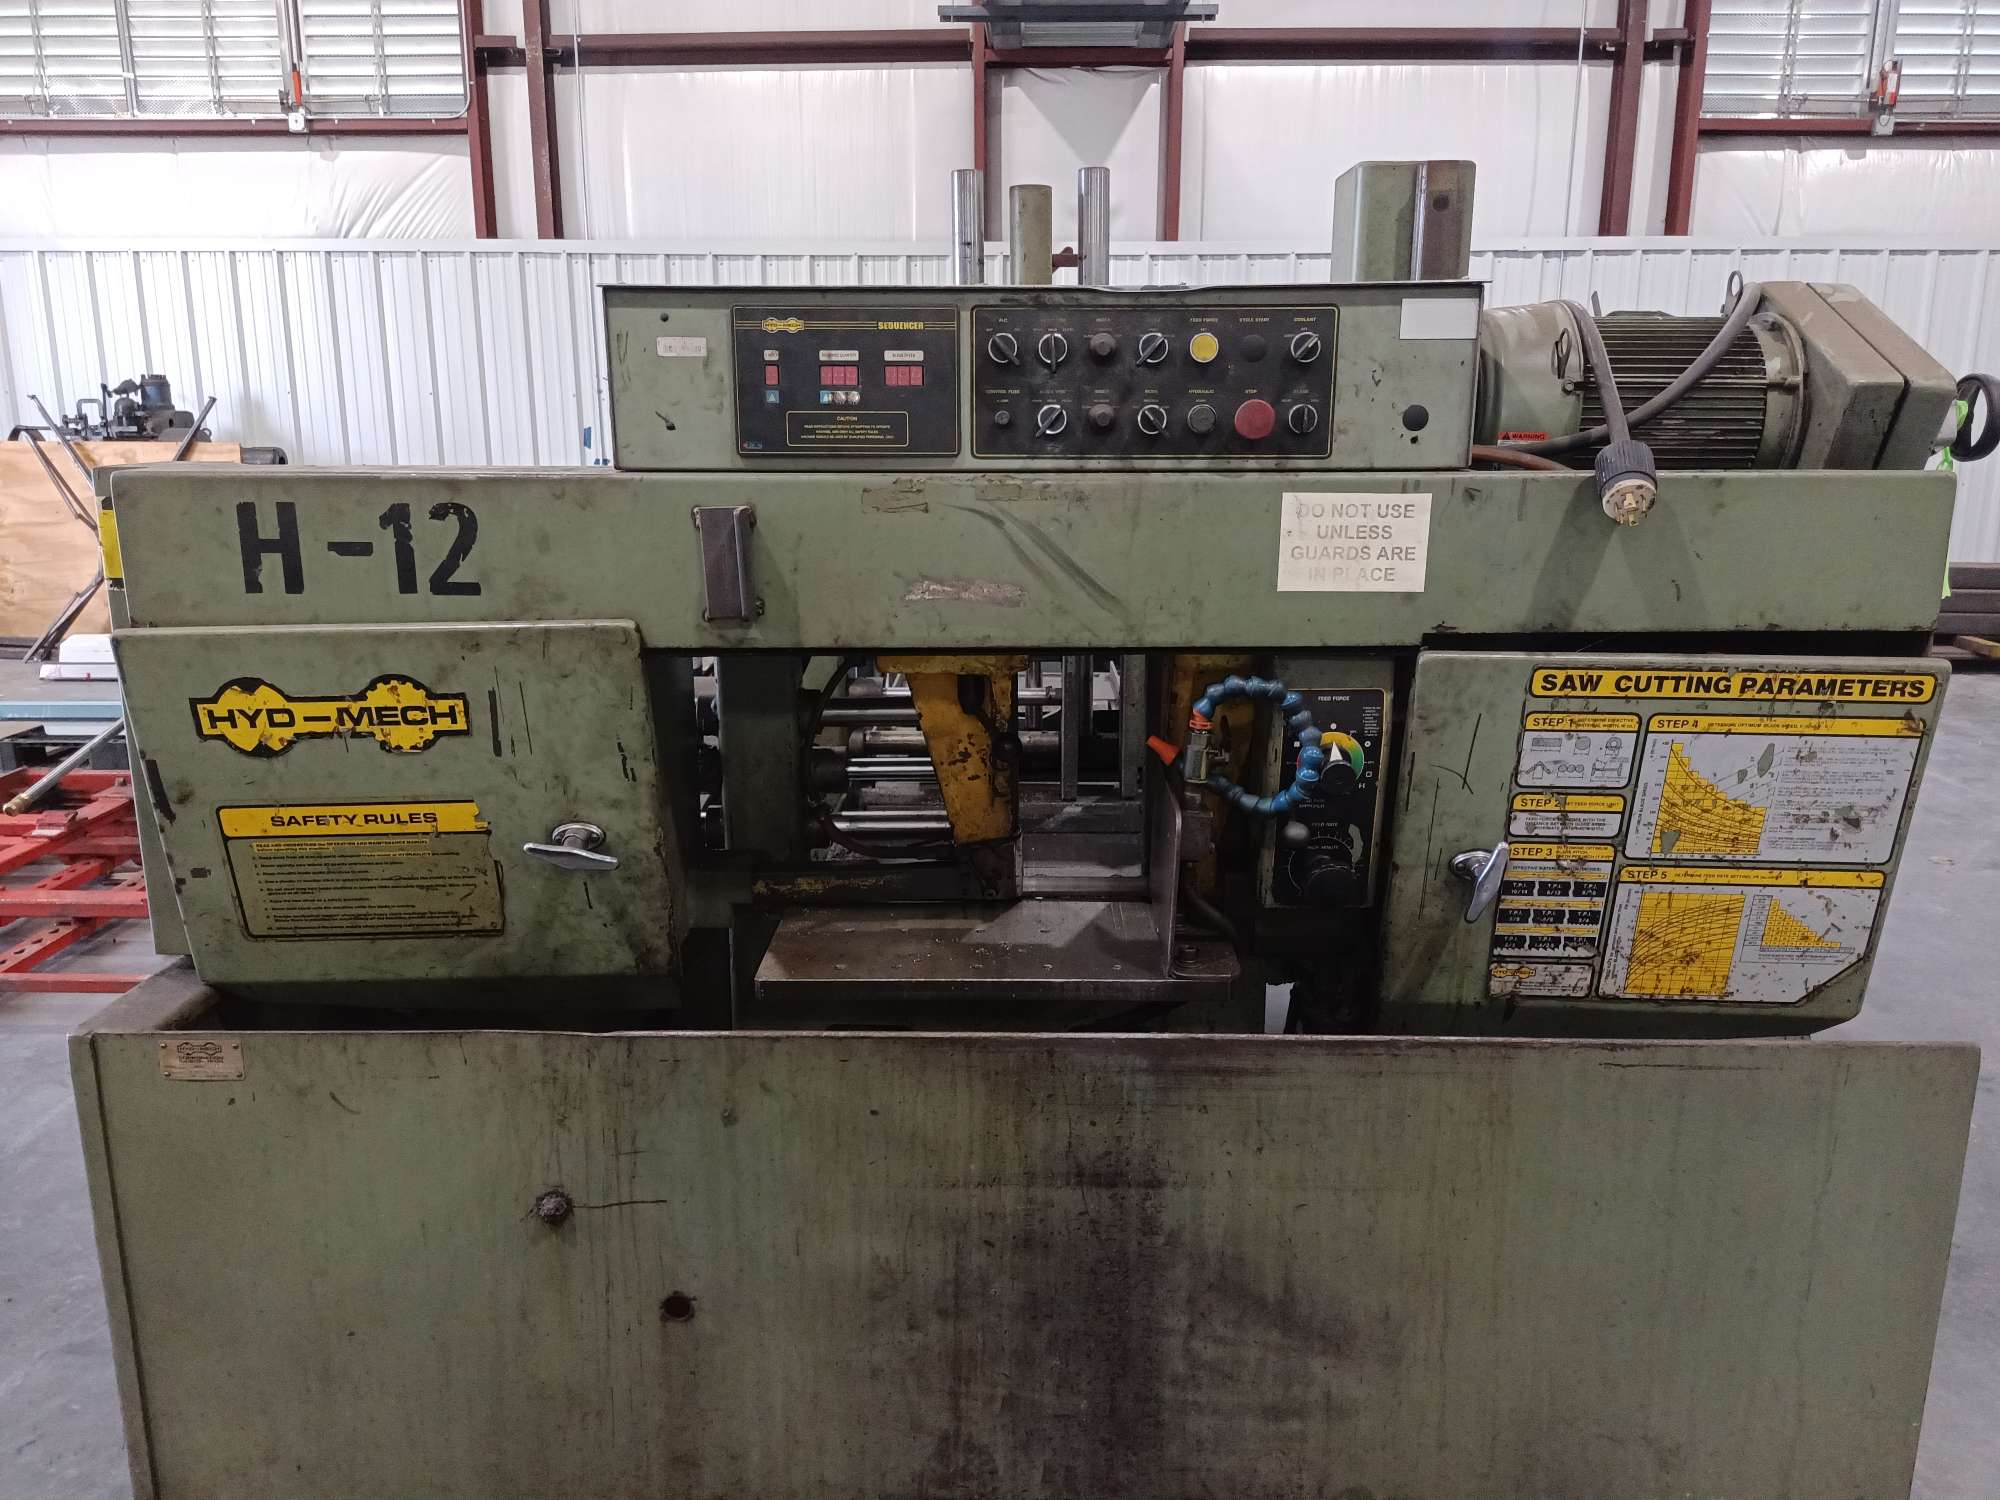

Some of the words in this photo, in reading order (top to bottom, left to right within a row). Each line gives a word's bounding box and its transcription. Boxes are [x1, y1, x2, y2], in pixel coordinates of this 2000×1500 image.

[877, 321, 925, 331] SEQUENCER
[1299, 503, 1326, 518] DO
[1331, 503, 1371, 518] NOT
[1377, 503, 1416, 519] USE
[1317, 525, 1393, 540] UNLESS
[1290, 546, 1372, 561] GUARDS
[1376, 546, 1416, 561] ARE
[1540, 673, 1603, 692] SAW
[1614, 675, 1732, 694] CUTTING
[1739, 677, 1926, 698] PARAMETERS
[206, 704, 458, 730] HYD-MECH
[1532, 717, 1564, 728] STEP
[1656, 719, 1690, 729] STEP
[1520, 798, 1552, 808] STEP
[270, 813, 358, 827] SAFETY
[363, 812, 438, 825] RULES
[1512, 847, 1543, 857] STEP
[1545, 847, 1553, 857] 3
[1627, 870, 1658, 880] STEP
[1660, 870, 1668, 880] 5
